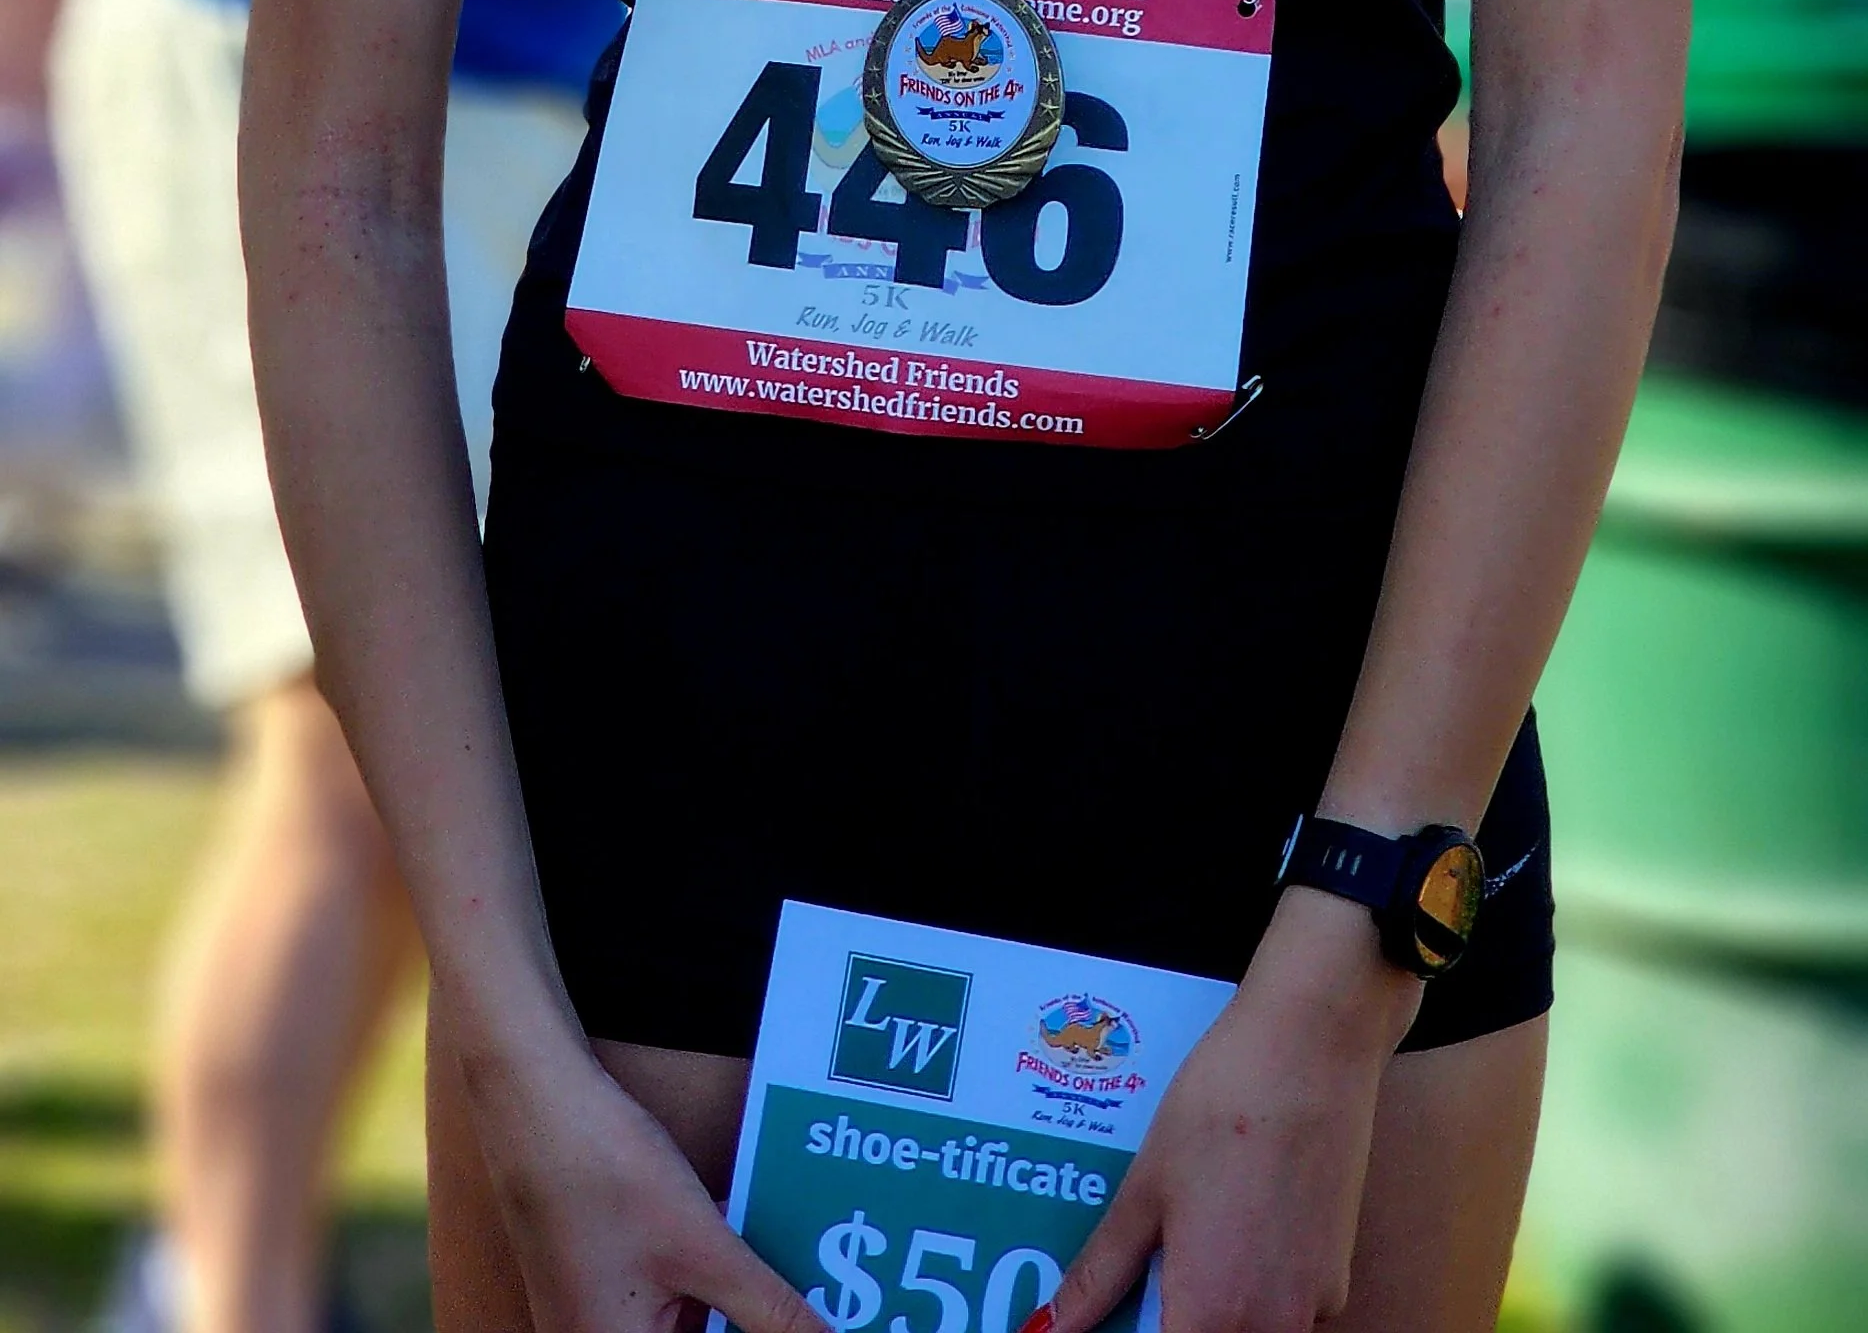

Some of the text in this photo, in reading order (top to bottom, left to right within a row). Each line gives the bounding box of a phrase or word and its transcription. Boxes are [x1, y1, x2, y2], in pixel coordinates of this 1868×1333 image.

[805, 40, 841, 62] MLA
[899, 74, 951, 105] FRIENDS
[954, 91, 975, 107] ON
[979, 83, 1001, 105] THE
[945, 135, 962, 148] Jog
[976, 135, 1002, 148] Walk
[948, 120, 971, 132] 5K
[693, 61, 1129, 306] 446
[836, 265, 889, 279] ANN
[861, 284, 912, 310] 5K
[796, 306, 979, 348] Run, Jog & Walk
[746, 340, 1020, 398] Watershed Friends
[679, 369, 1084, 434] www.watershedfriends.com
[1016, 1051, 1069, 1086] FRIENDS
[1073, 1076, 1095, 1091] ON
[1099, 1075, 1122, 1091] THE
[1062, 1102, 1085, 1116] 5K
[805, 1115, 1106, 1206] shoe-tificate
